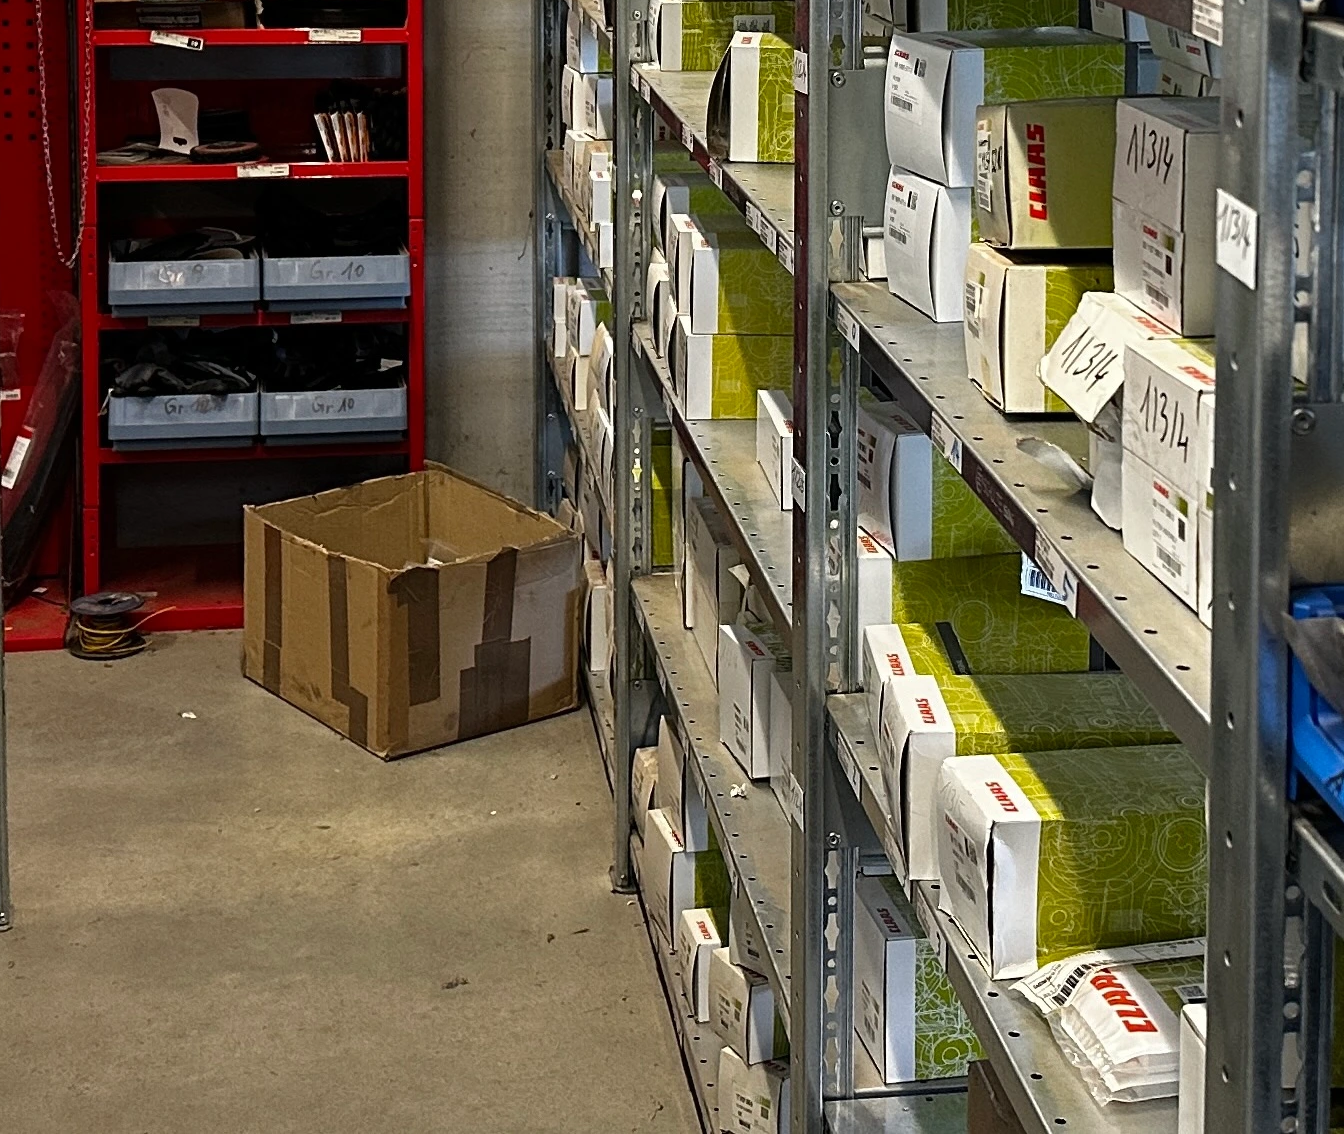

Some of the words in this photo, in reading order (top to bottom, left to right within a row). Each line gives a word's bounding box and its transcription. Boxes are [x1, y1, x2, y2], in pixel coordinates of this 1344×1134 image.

[1027, 122, 1048, 221] CLAAS
[341, 261, 366, 281] 10
[337, 398, 355, 413] 10
[985, 781, 1020, 813] CLAAS
